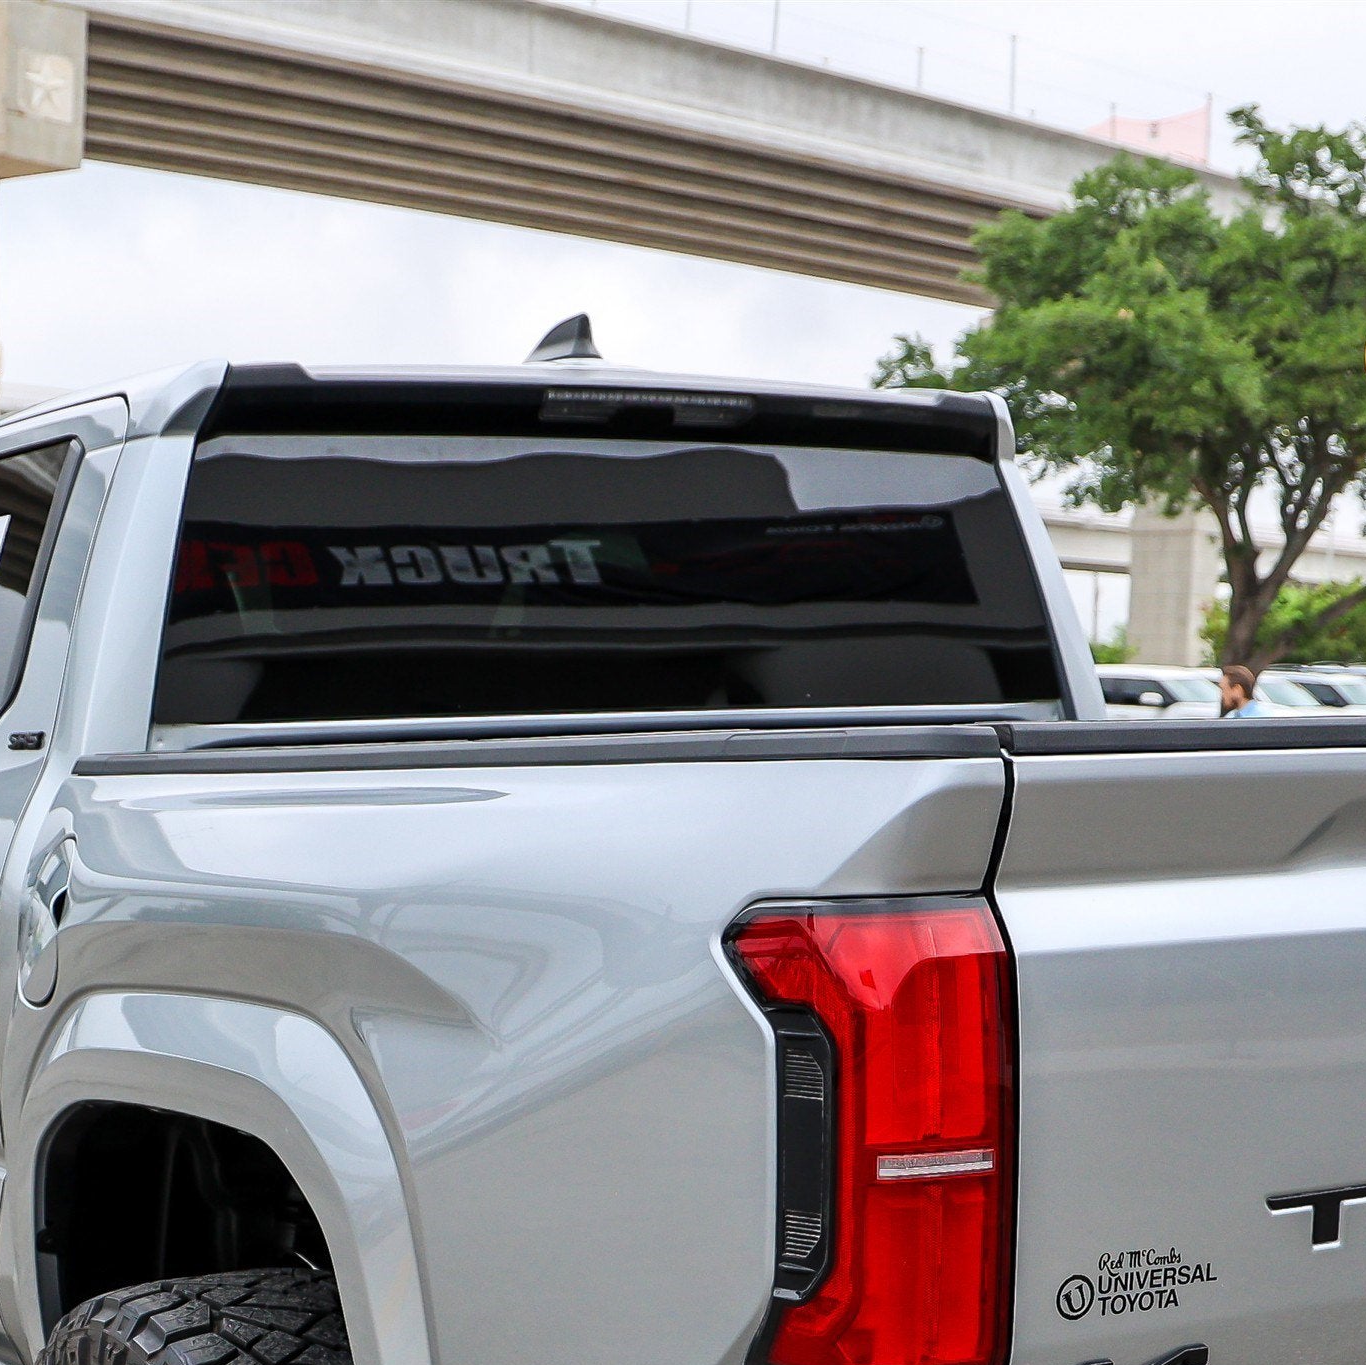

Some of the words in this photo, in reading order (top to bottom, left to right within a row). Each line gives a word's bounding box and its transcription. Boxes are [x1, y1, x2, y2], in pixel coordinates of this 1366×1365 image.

[1097, 1262, 1218, 1295] UNIVERSAL
[1098, 1252, 1125, 1277] Red
[1097, 1288, 1180, 1317] TOYOTA
